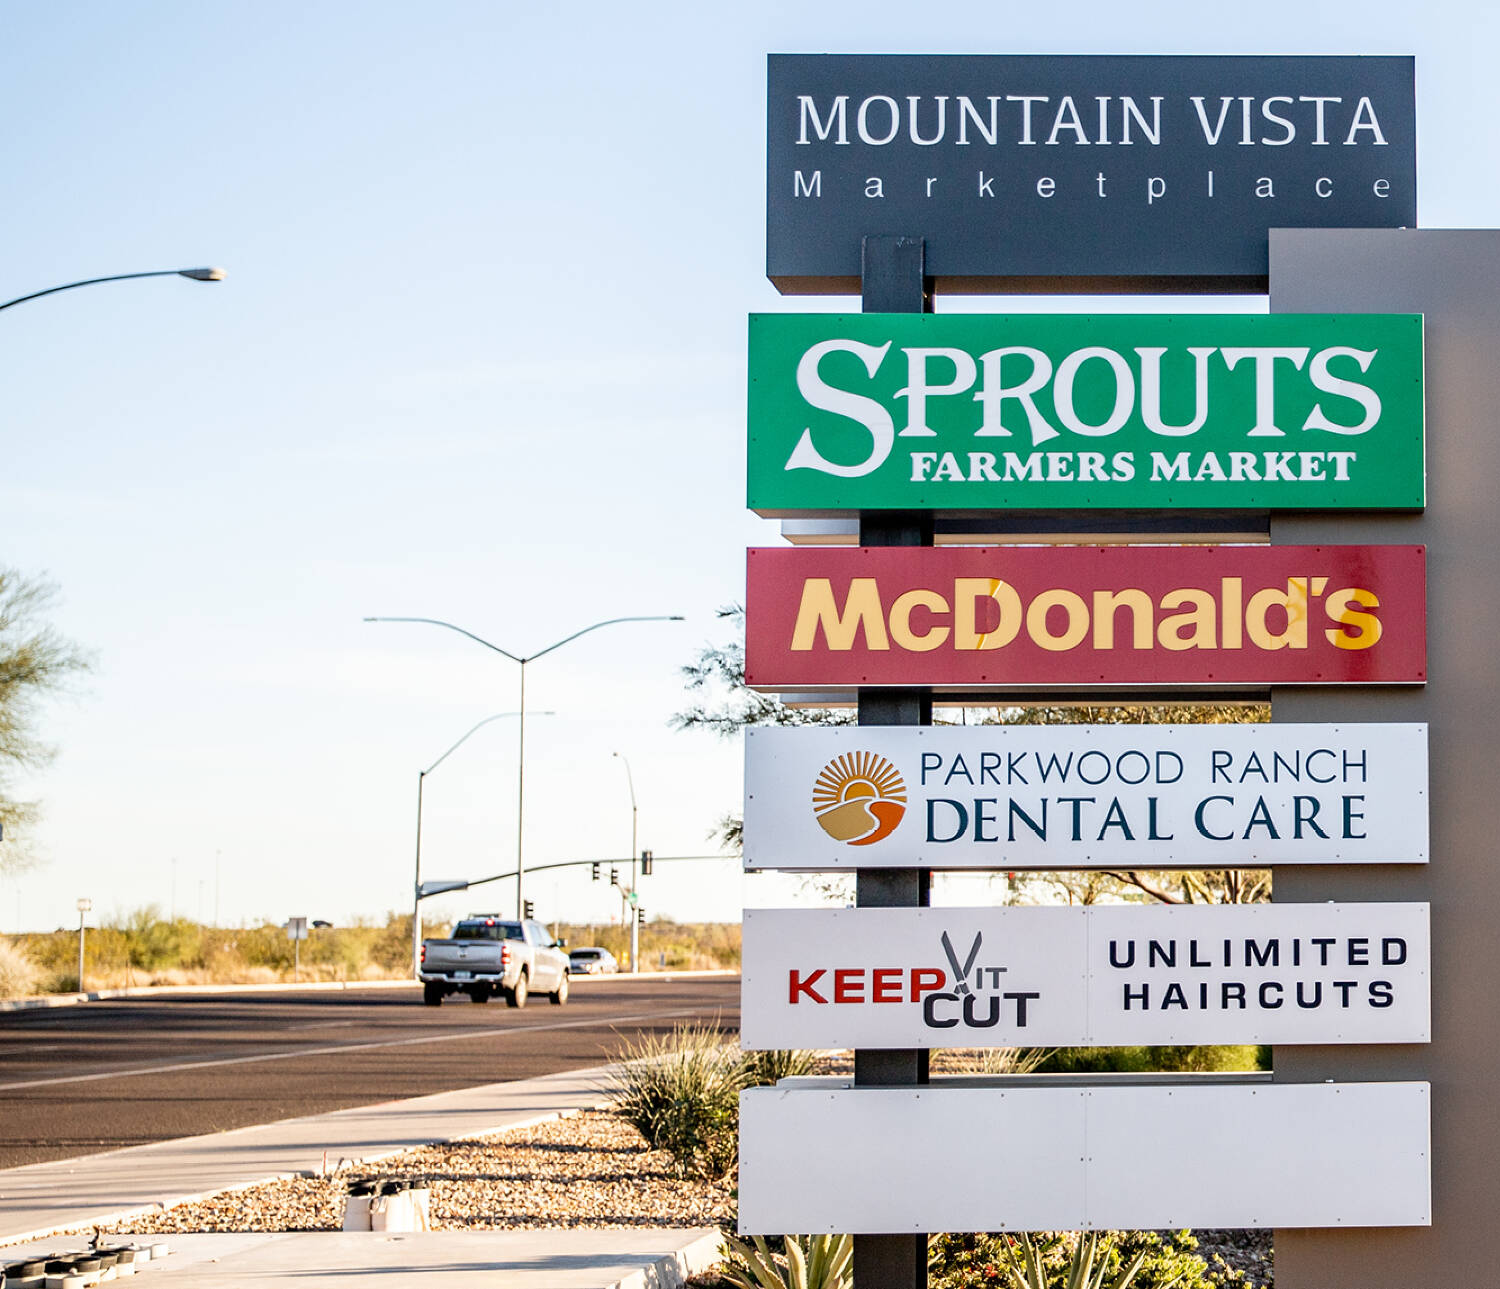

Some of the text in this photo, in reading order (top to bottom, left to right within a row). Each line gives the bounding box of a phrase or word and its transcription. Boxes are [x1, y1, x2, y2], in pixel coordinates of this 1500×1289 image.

[795, 95, 1389, 146] MOUNTAIN VISTA
[794, 170, 1390, 205] Marketplace
[784, 339, 1382, 478] SPROUTS
[910, 451, 1357, 482] FARMERS MARKET
[790, 576, 1383, 652] McDonald's
[921, 748, 1367, 786] PARKWOOD RANCH
[925, 794, 1367, 844] DENTAL CARE
[1109, 937, 1407, 969] UNLIMITED
[788, 967, 1008, 1005] KEEP IT
[1123, 980, 1394, 1011] HAIRCUTS
[922, 992, 1041, 1029] CUT
